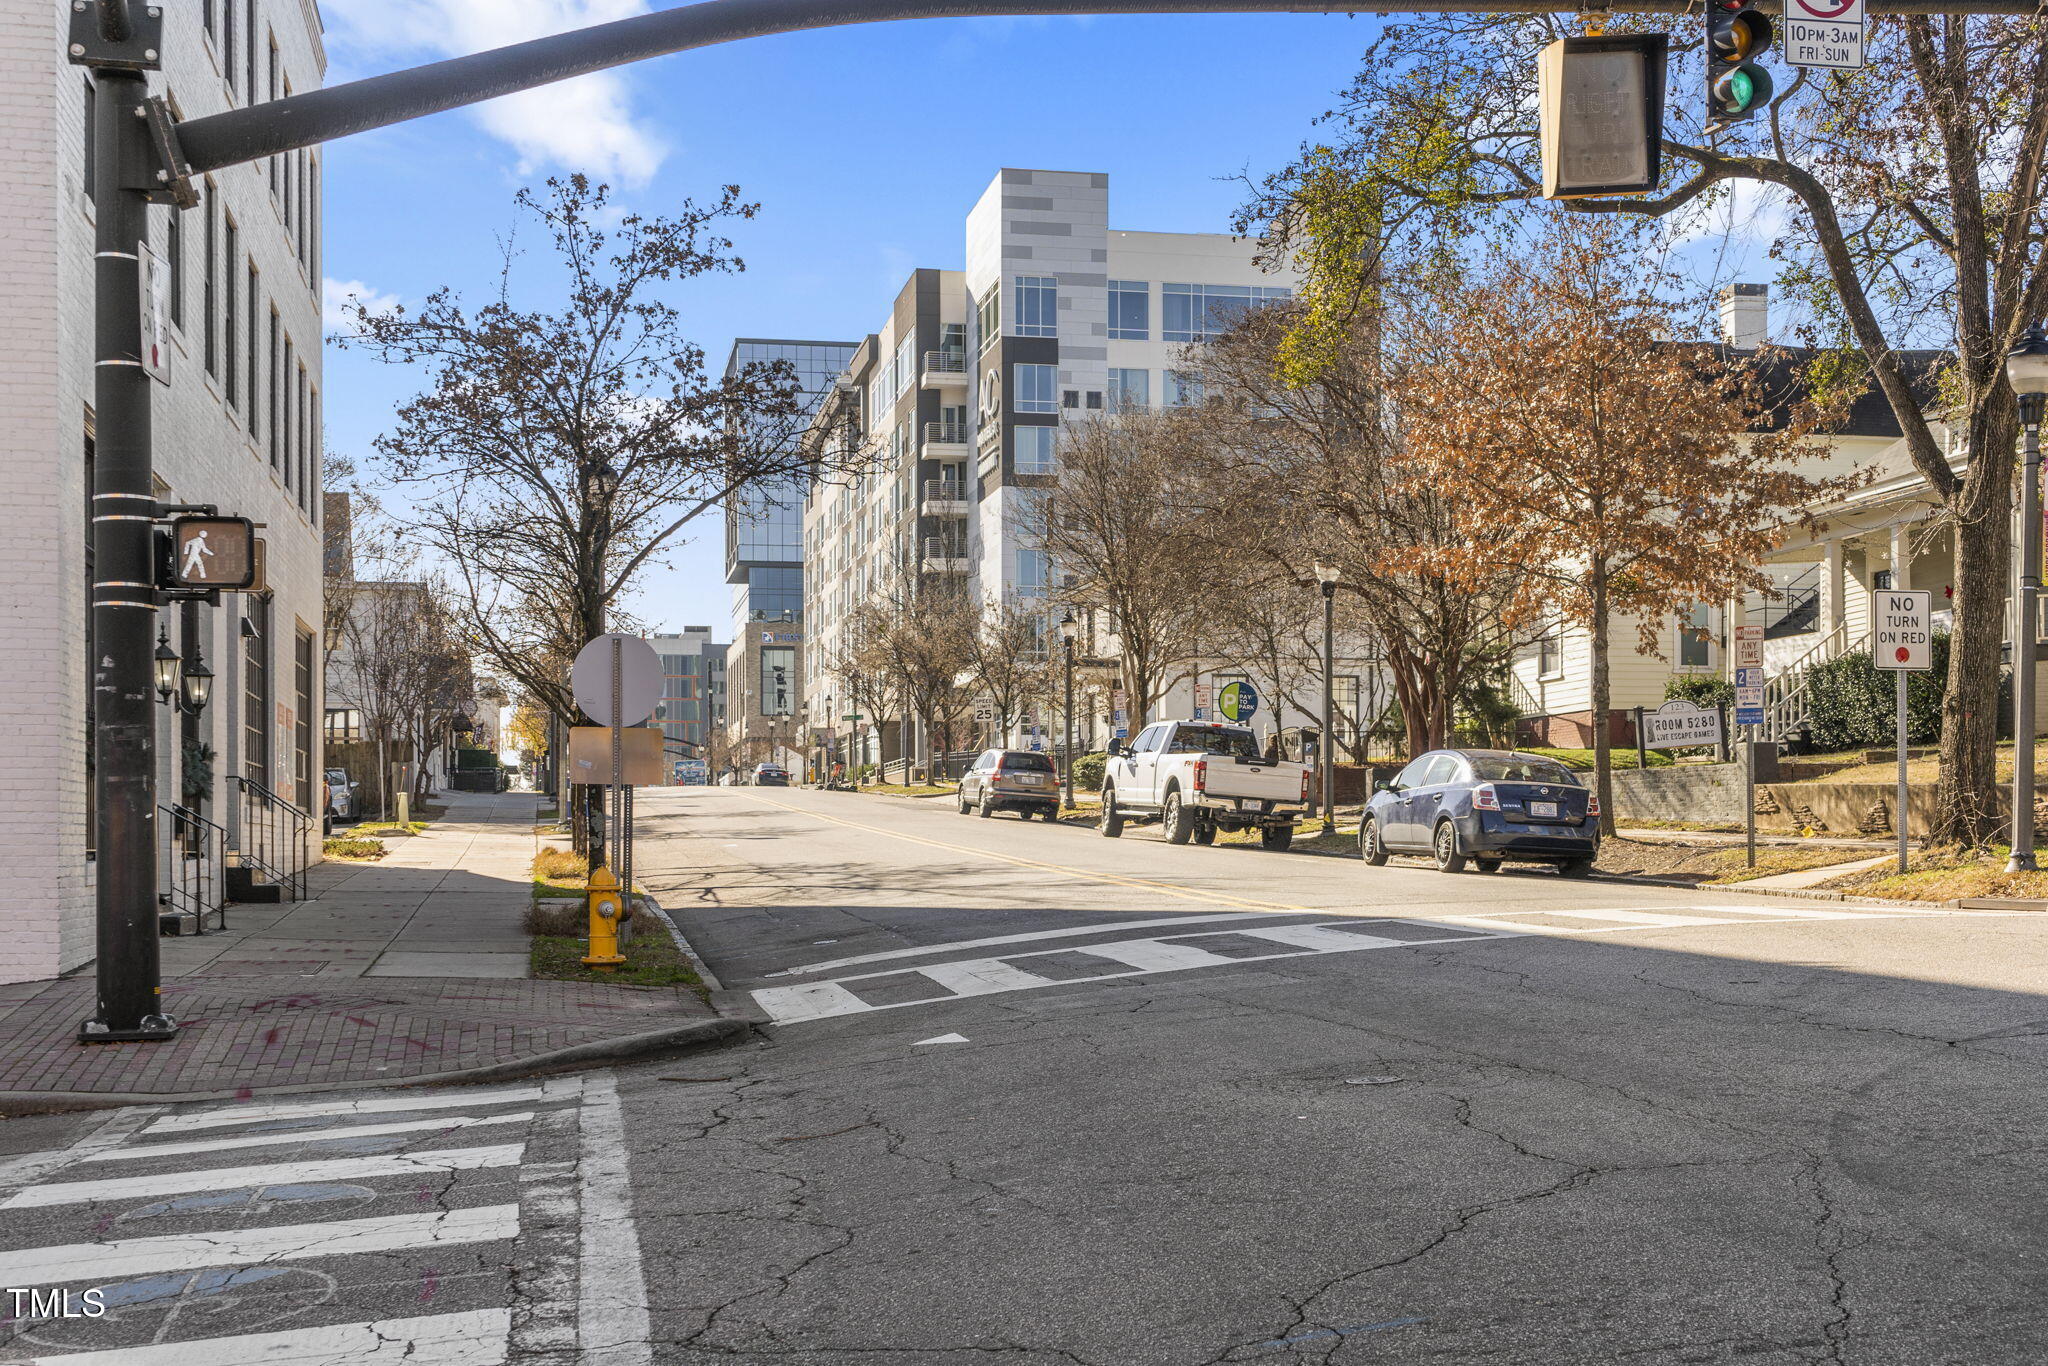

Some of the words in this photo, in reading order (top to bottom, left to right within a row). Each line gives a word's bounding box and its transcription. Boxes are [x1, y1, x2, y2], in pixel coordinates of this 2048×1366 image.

[1791, 25, 1858, 43] 10PM-3AM
[1799, 46, 1849, 61] FRI-SUN
[1891, 597, 1914, 611] NO
[1886, 615, 1919, 628] TURN
[1880, 631, 1896, 643] ON
[1902, 632, 1926, 644] RED
[1741, 641, 1757, 650] ANY
[1740, 650, 1759, 659] TIME
[1738, 671, 1745, 684] 2
[1223, 693, 1236, 708] P
[1671, 703, 1685, 711] 123
[976, 709, 993, 720] 25
[1655, 719, 1683, 731] ROOM
[1687, 715, 1715, 729] 5280
[1656, 733, 1669, 741] LIVE
[1670, 731, 1692, 740] ESCAPE
[1693, 729, 1715, 738] GAMES
